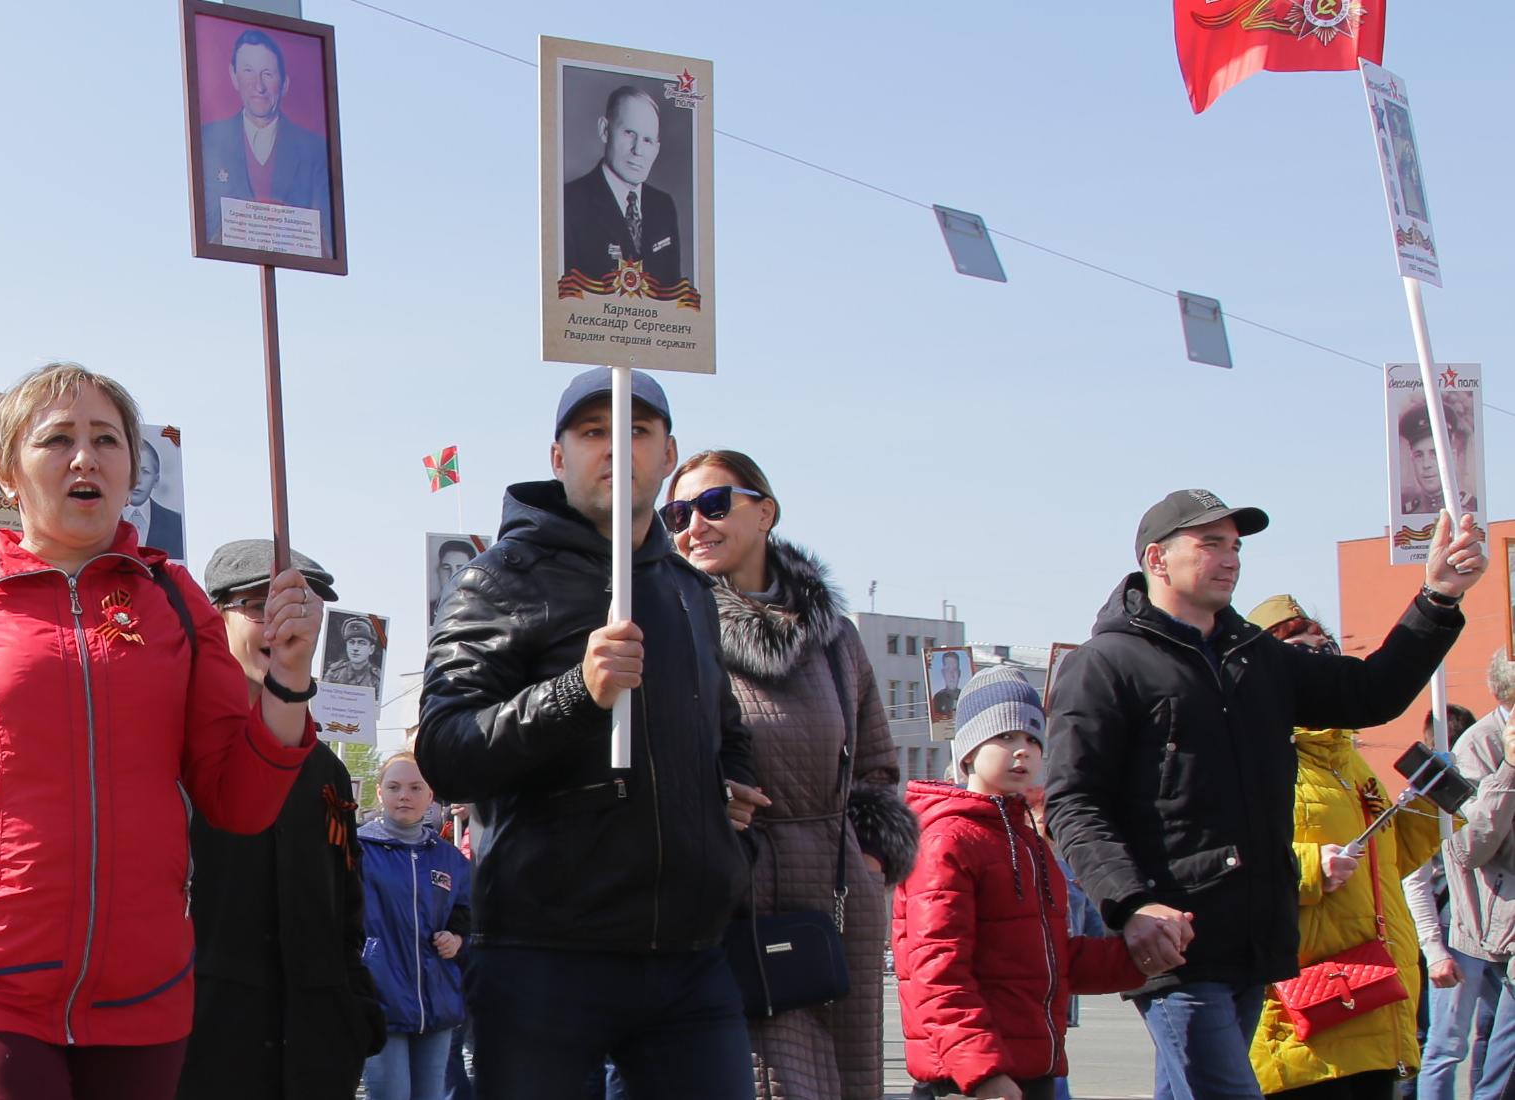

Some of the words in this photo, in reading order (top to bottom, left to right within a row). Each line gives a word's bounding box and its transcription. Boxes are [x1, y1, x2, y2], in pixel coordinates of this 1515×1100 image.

[603, 303, 658, 319] Карманов
[567, 313, 629, 332] Александр
[634, 318, 692, 335] Сергеевич
[564, 329, 605, 343] Гвардии
[609, 335, 653, 347] старший
[656, 339, 697, 350] сержант
